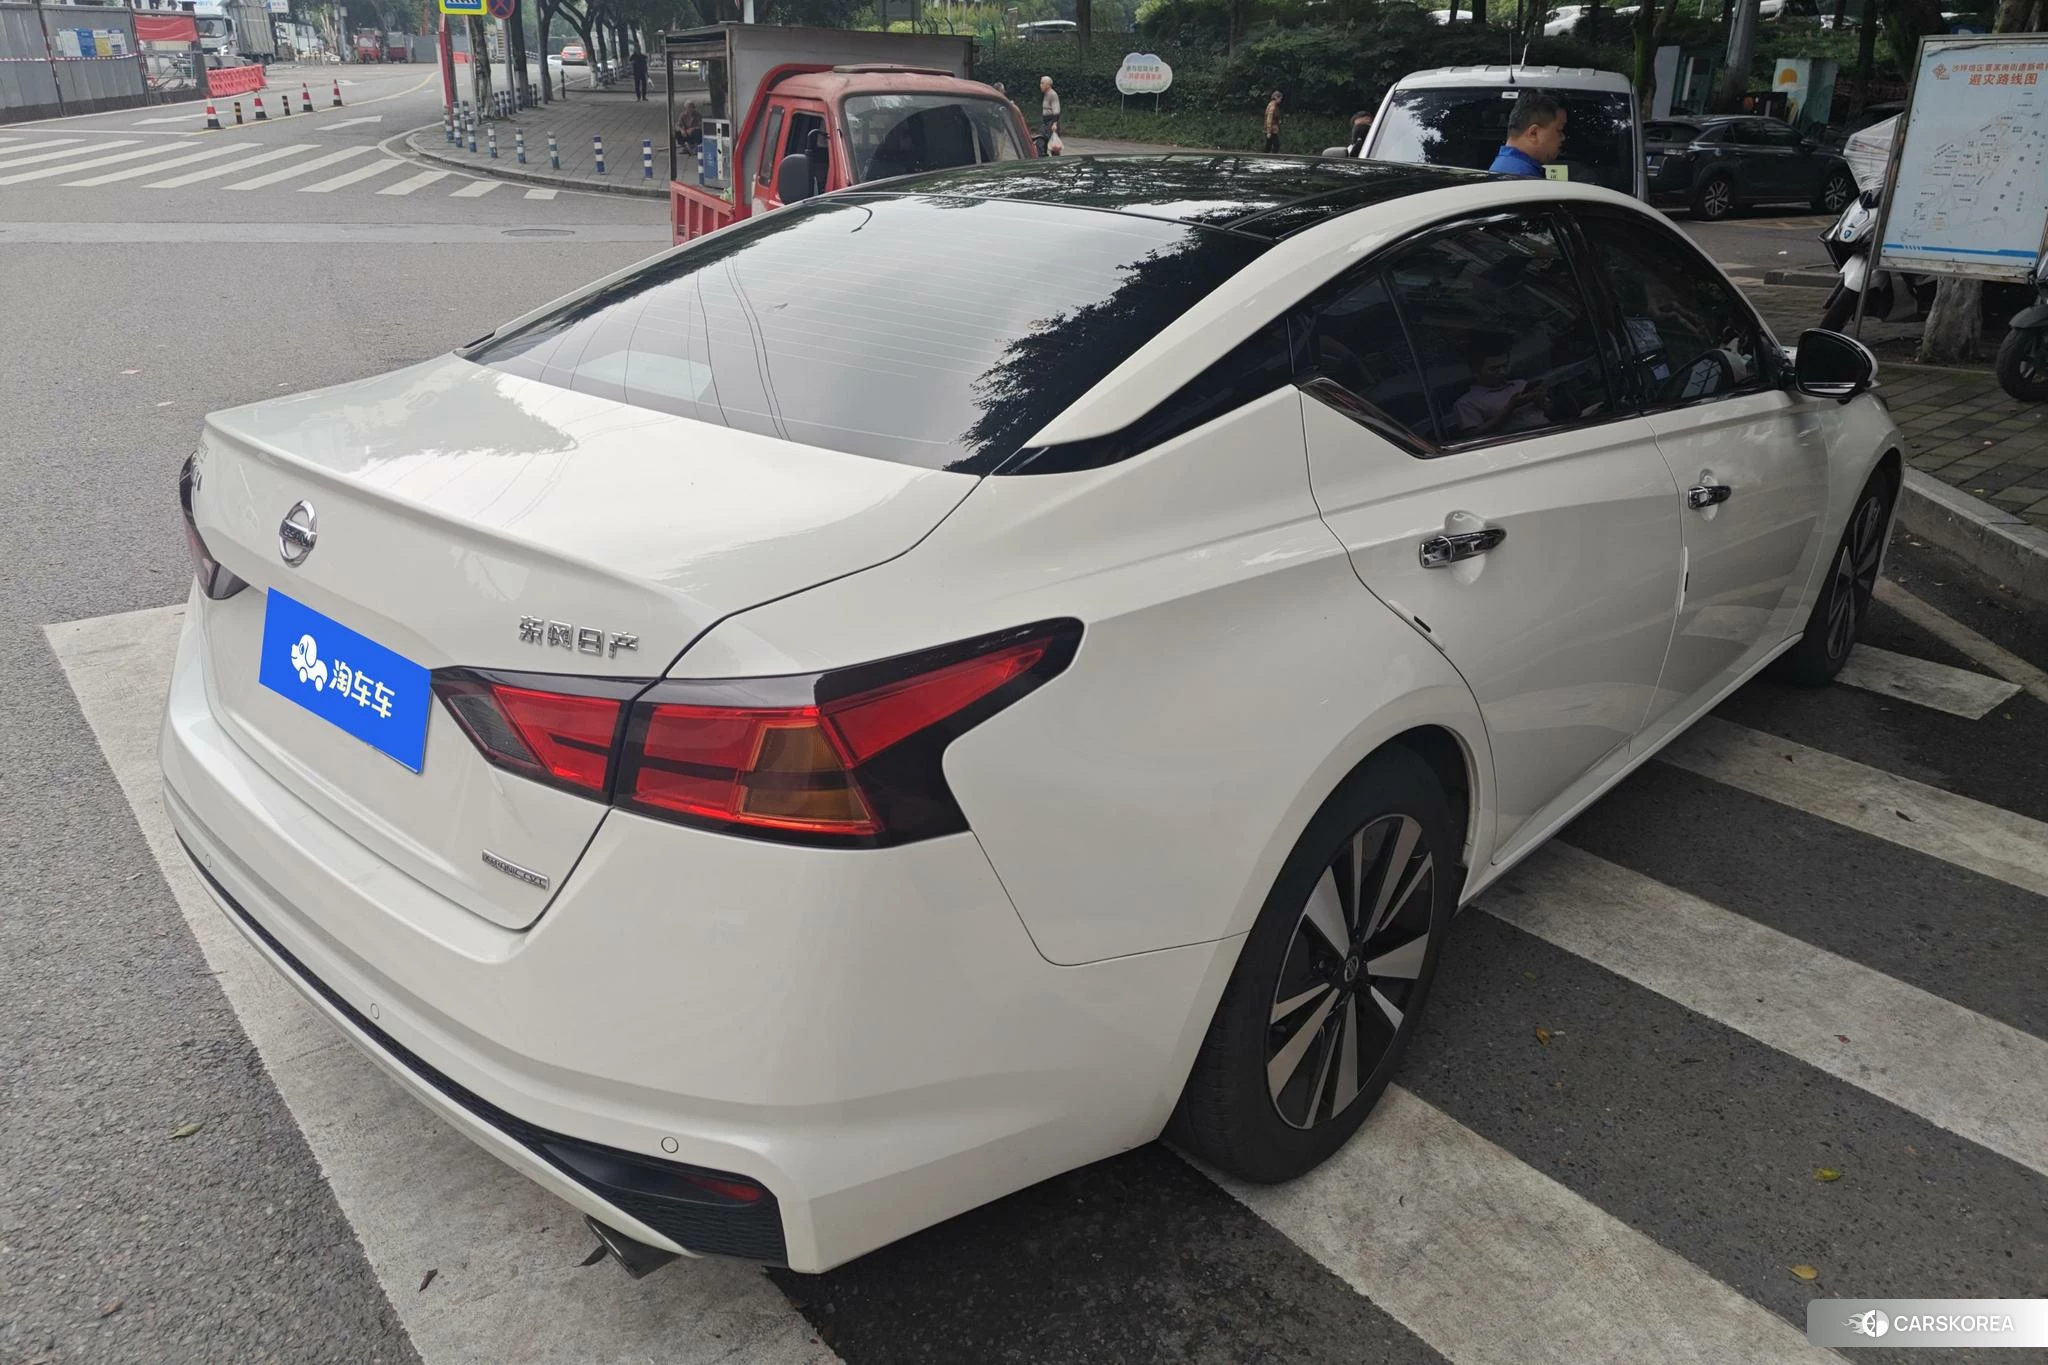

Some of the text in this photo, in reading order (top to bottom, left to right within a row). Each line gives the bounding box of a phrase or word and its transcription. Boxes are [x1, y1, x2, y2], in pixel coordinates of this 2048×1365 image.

[1968, 73, 2038, 86] 避灾路线图
[519, 615, 639, 659] 东风日产
